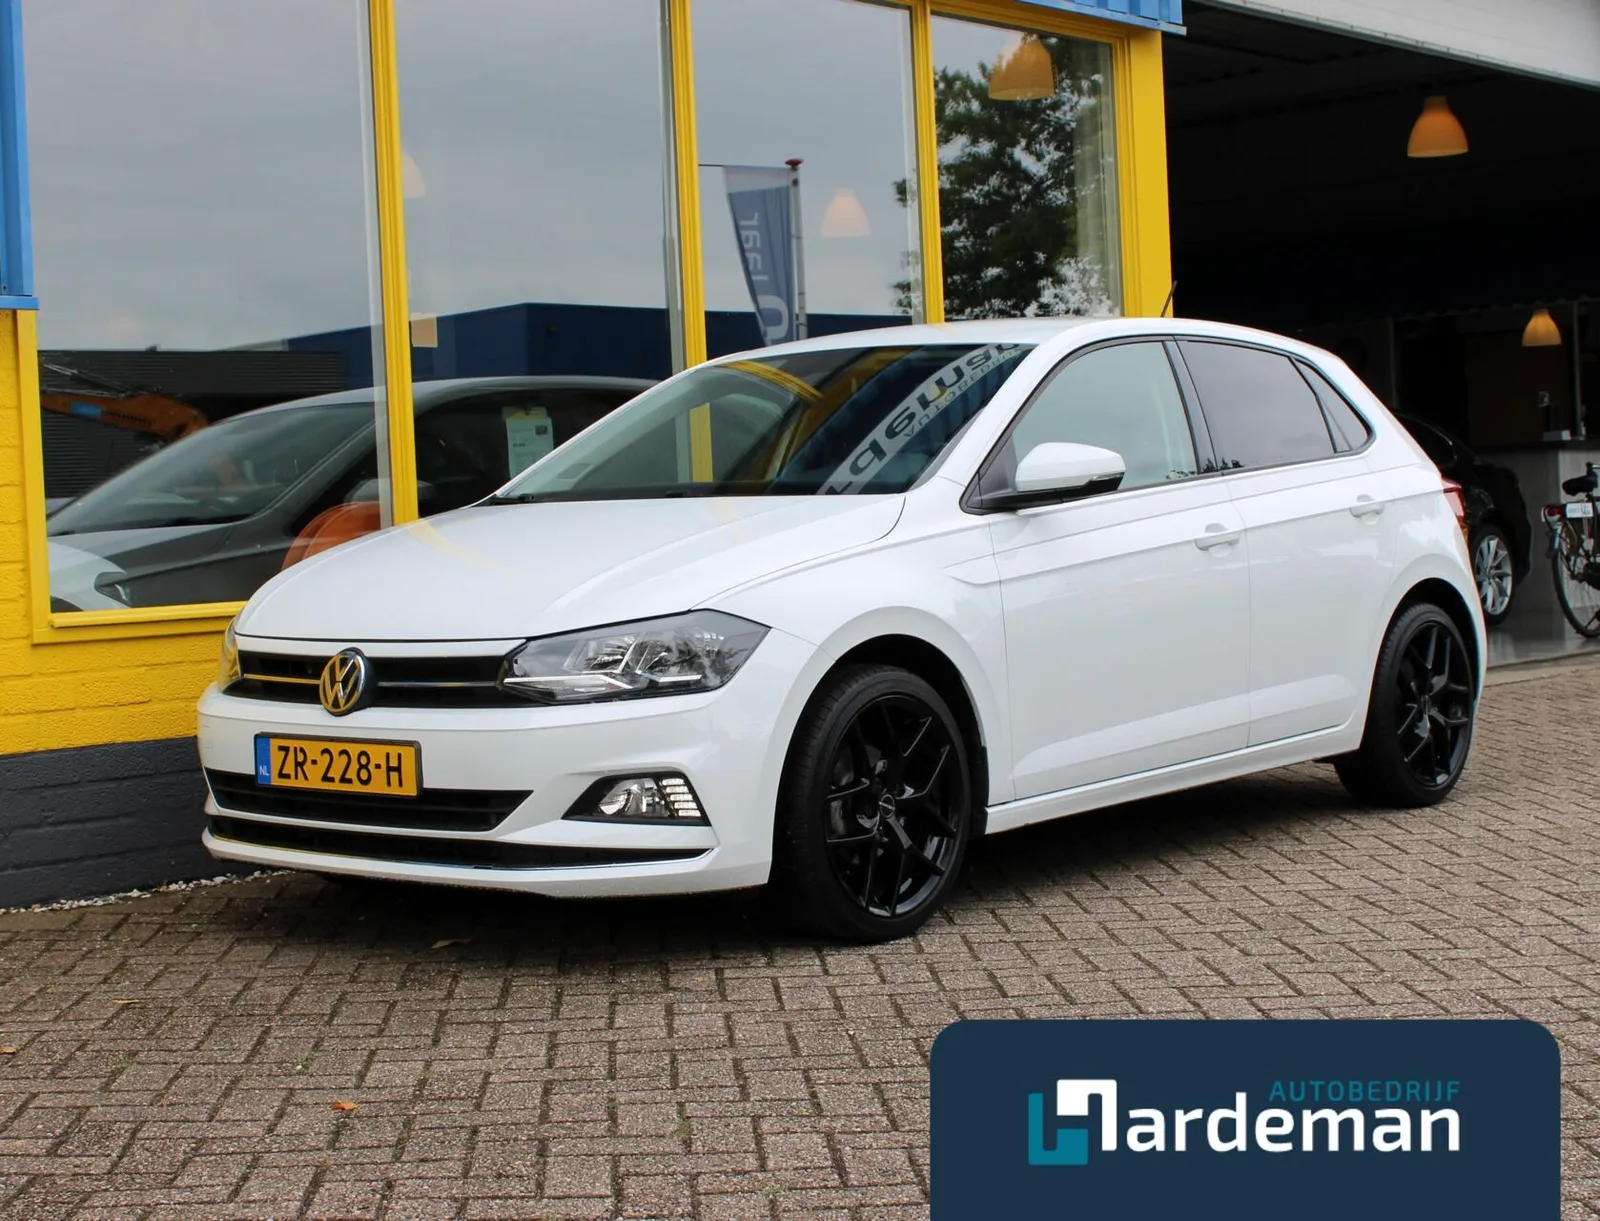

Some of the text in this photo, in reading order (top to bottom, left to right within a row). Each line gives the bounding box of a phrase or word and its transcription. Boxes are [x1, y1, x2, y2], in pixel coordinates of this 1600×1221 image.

[320, 650, 366, 713] VW
[259, 745, 404, 788] NL ZR-228-H
